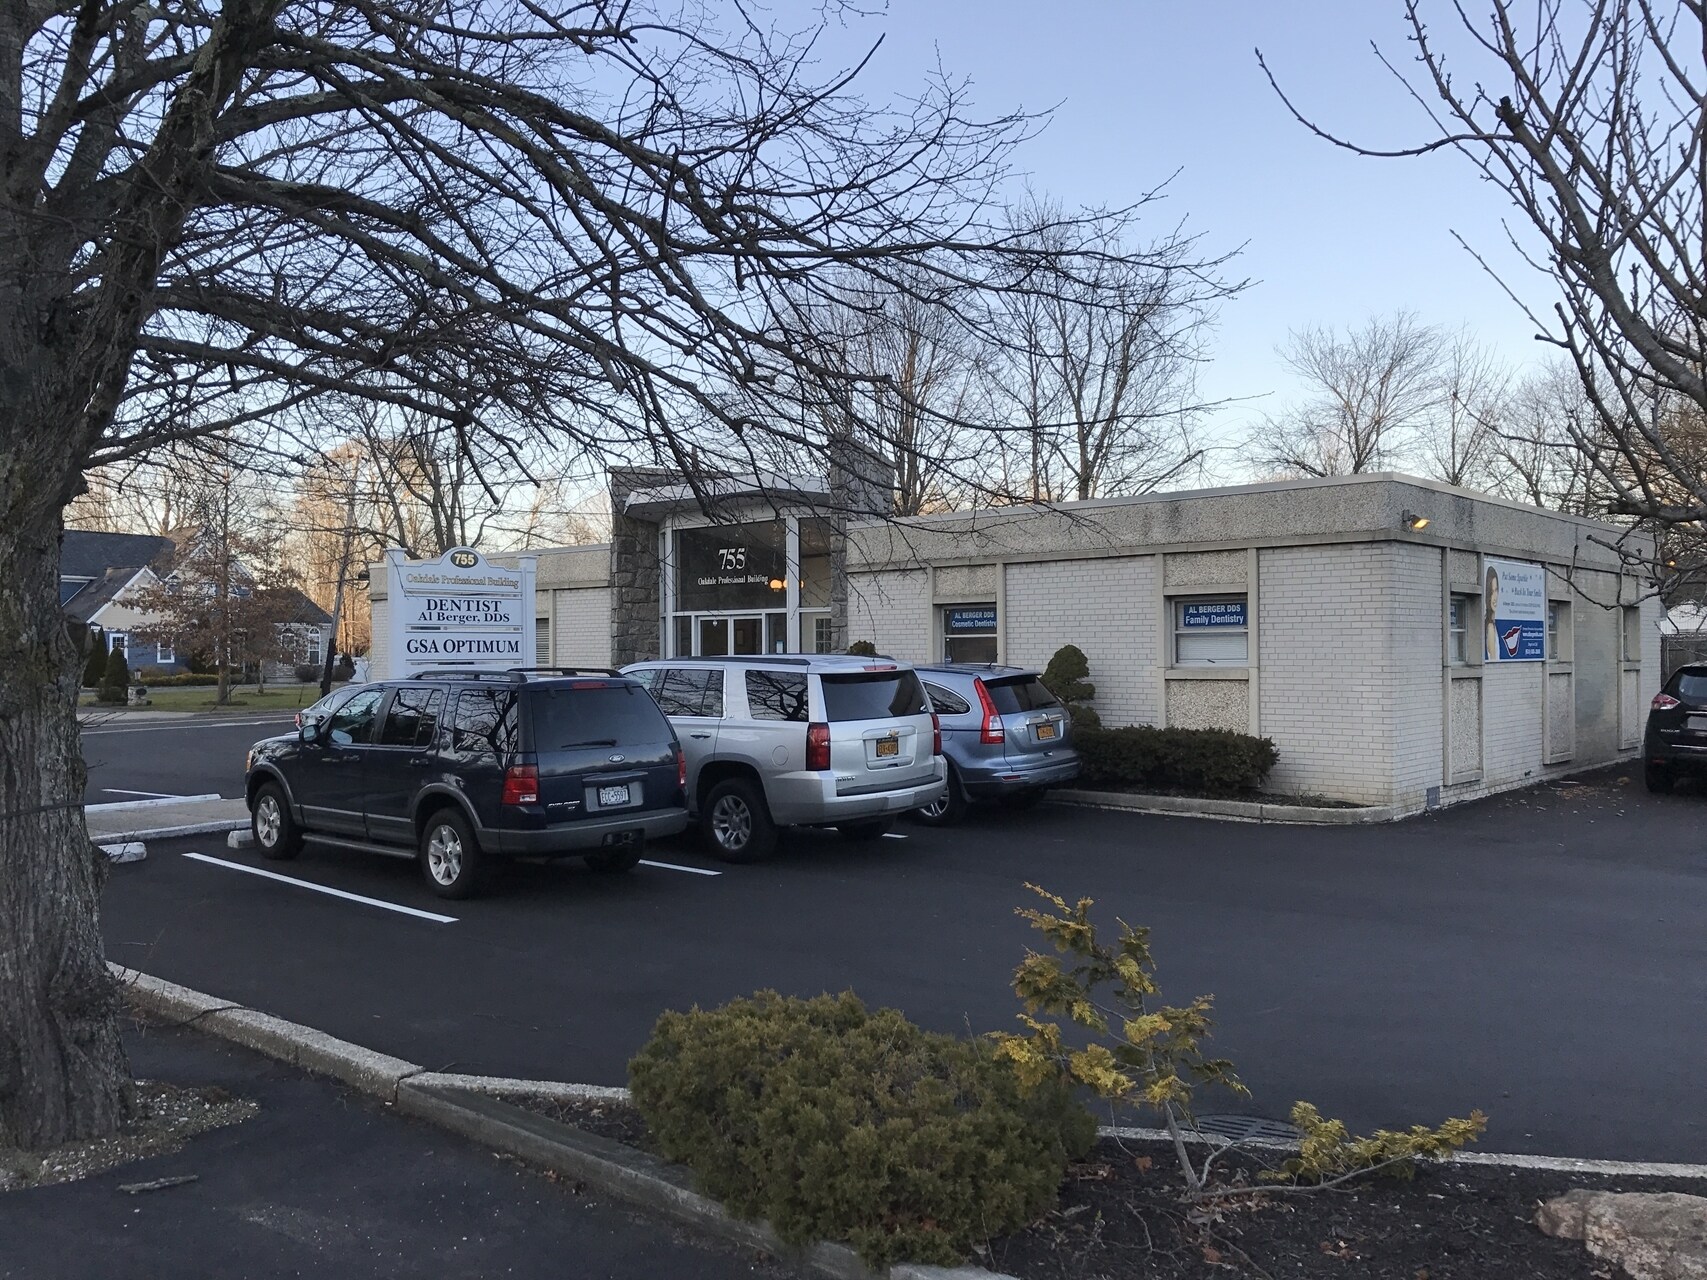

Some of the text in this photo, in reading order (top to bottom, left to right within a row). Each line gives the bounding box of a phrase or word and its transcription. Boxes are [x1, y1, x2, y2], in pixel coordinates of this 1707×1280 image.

[454, 553, 475, 566] 755
[718, 547, 746, 570] 755
[406, 573, 519, 589] Oakdale Professional Building
[697, 574, 769, 586] Oakdale Professional Building
[426, 598, 502, 612] DENTIST
[1199, 605, 1226, 613] BERGER
[418, 612, 510, 625] Al Berger, DDS
[951, 619, 997, 628] Cosmetic Dentistry
[1185, 614, 1244, 625] Family Dentistry
[406, 638, 520, 654] GSA OPTIMUM
